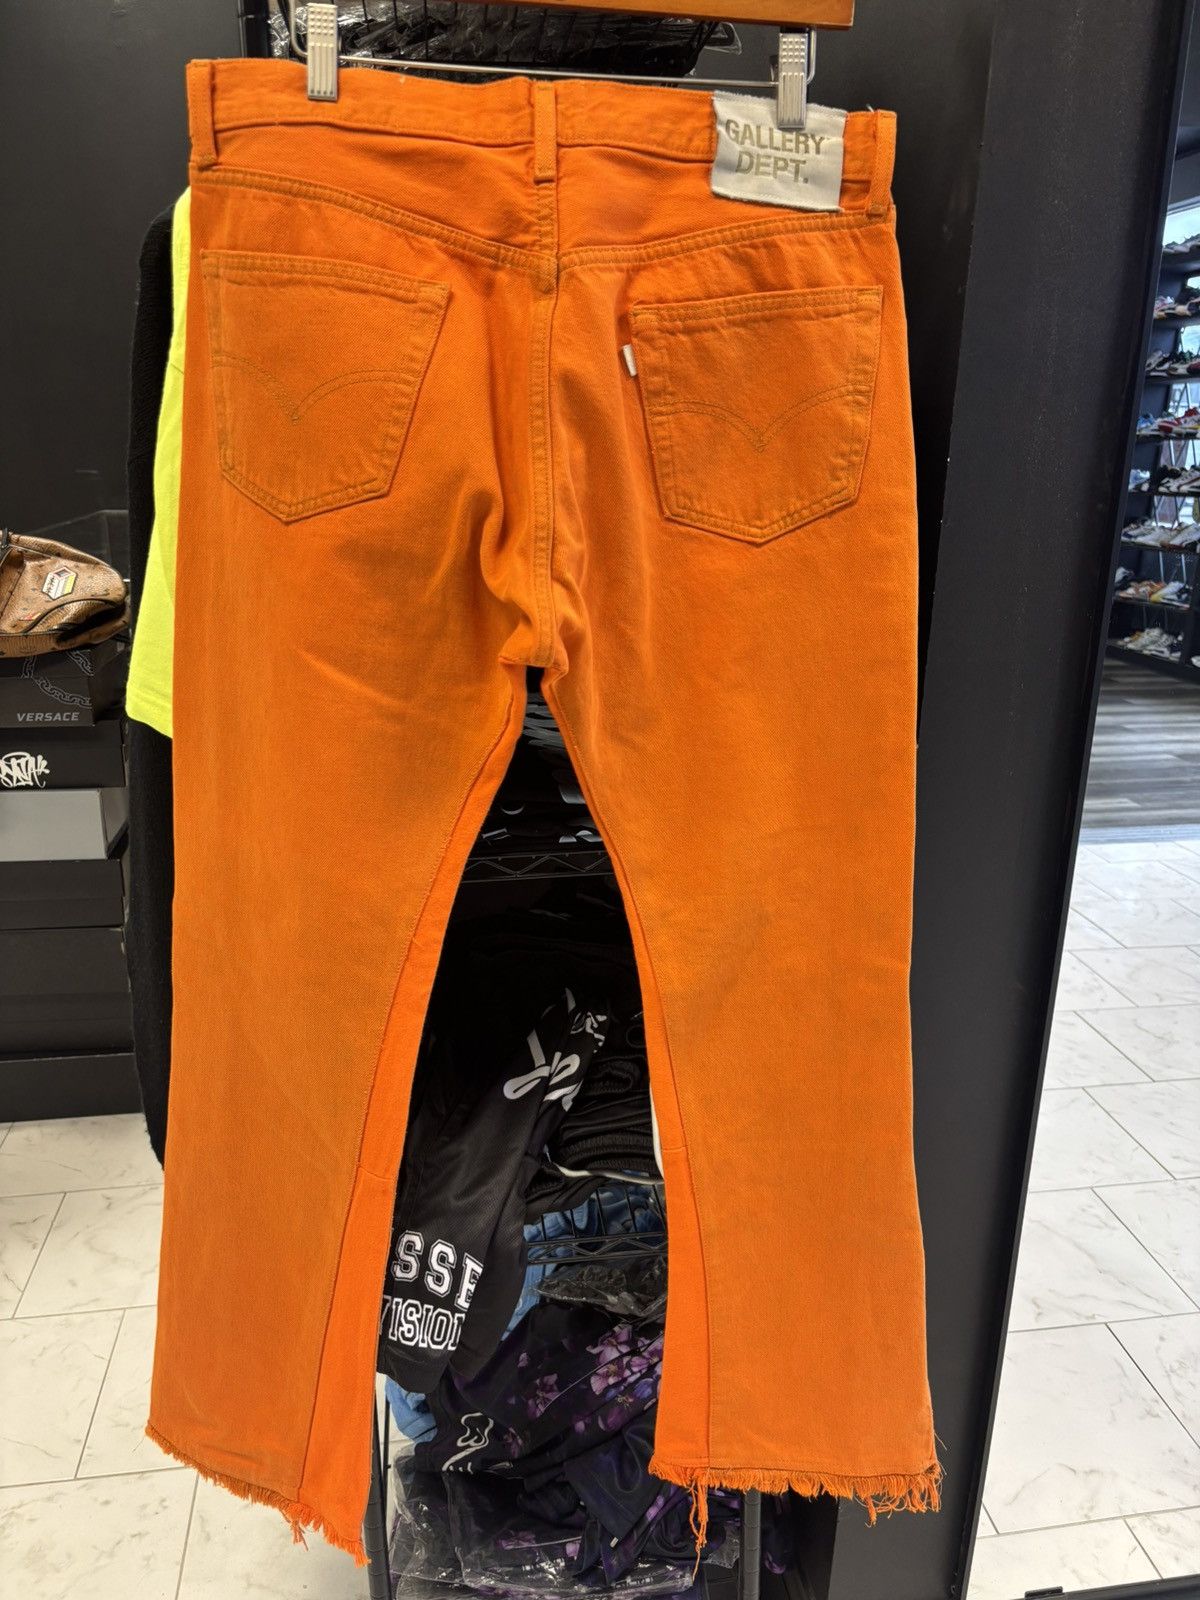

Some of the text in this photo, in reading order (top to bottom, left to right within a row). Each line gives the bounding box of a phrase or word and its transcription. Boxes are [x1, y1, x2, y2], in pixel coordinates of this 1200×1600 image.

[725, 118, 825, 156] GALLERY
[735, 150, 810, 185] DEPT.
[16, 711, 80, 722] VERSACE
